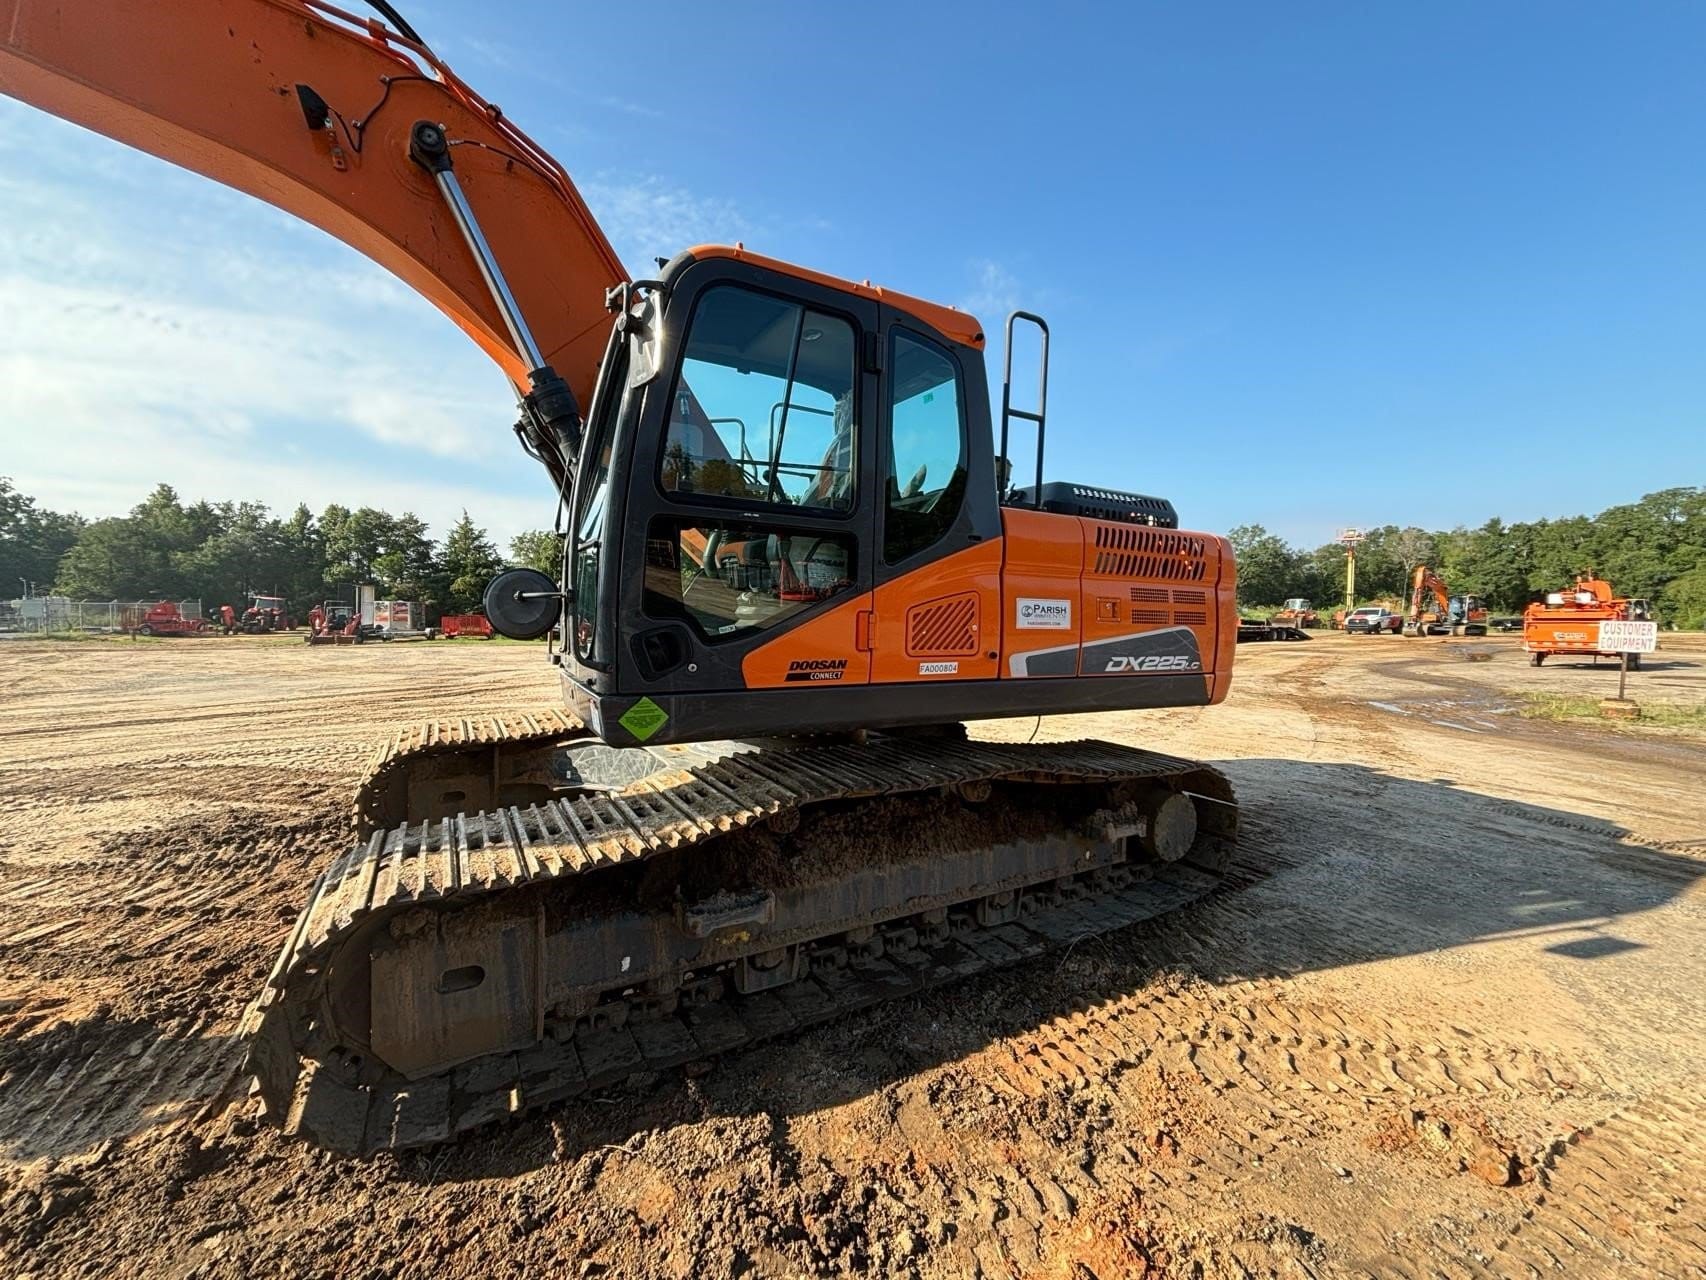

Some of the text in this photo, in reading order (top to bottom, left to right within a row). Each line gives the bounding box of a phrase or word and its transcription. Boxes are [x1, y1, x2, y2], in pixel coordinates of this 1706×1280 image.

[1033, 604, 1067, 614] PARISH
[1603, 622, 1653, 636] CUSTOMER
[1600, 636, 1654, 651] EQUIPMENT
[790, 659, 848, 671] DOOSAN
[810, 671, 842, 680] CONNECT
